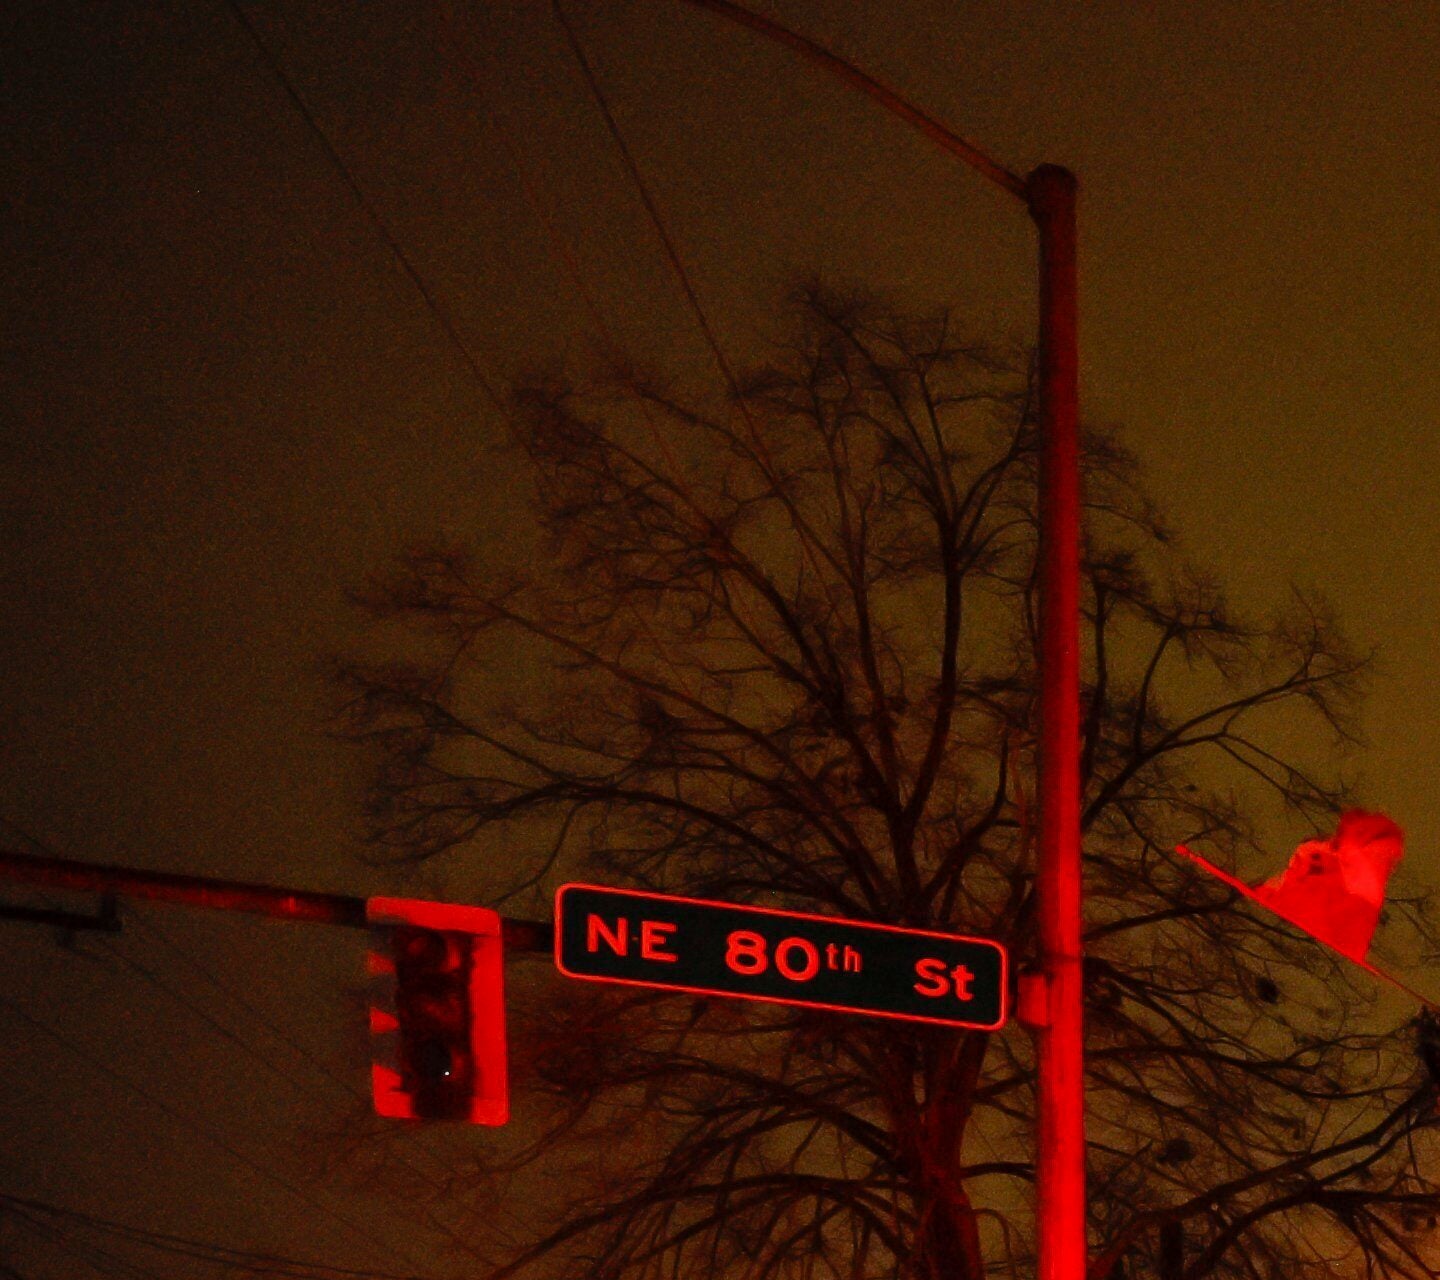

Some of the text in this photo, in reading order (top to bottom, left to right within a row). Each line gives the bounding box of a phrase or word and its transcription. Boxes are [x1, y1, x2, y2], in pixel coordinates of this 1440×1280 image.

[587, 914, 975, 1001] NE 80th St
